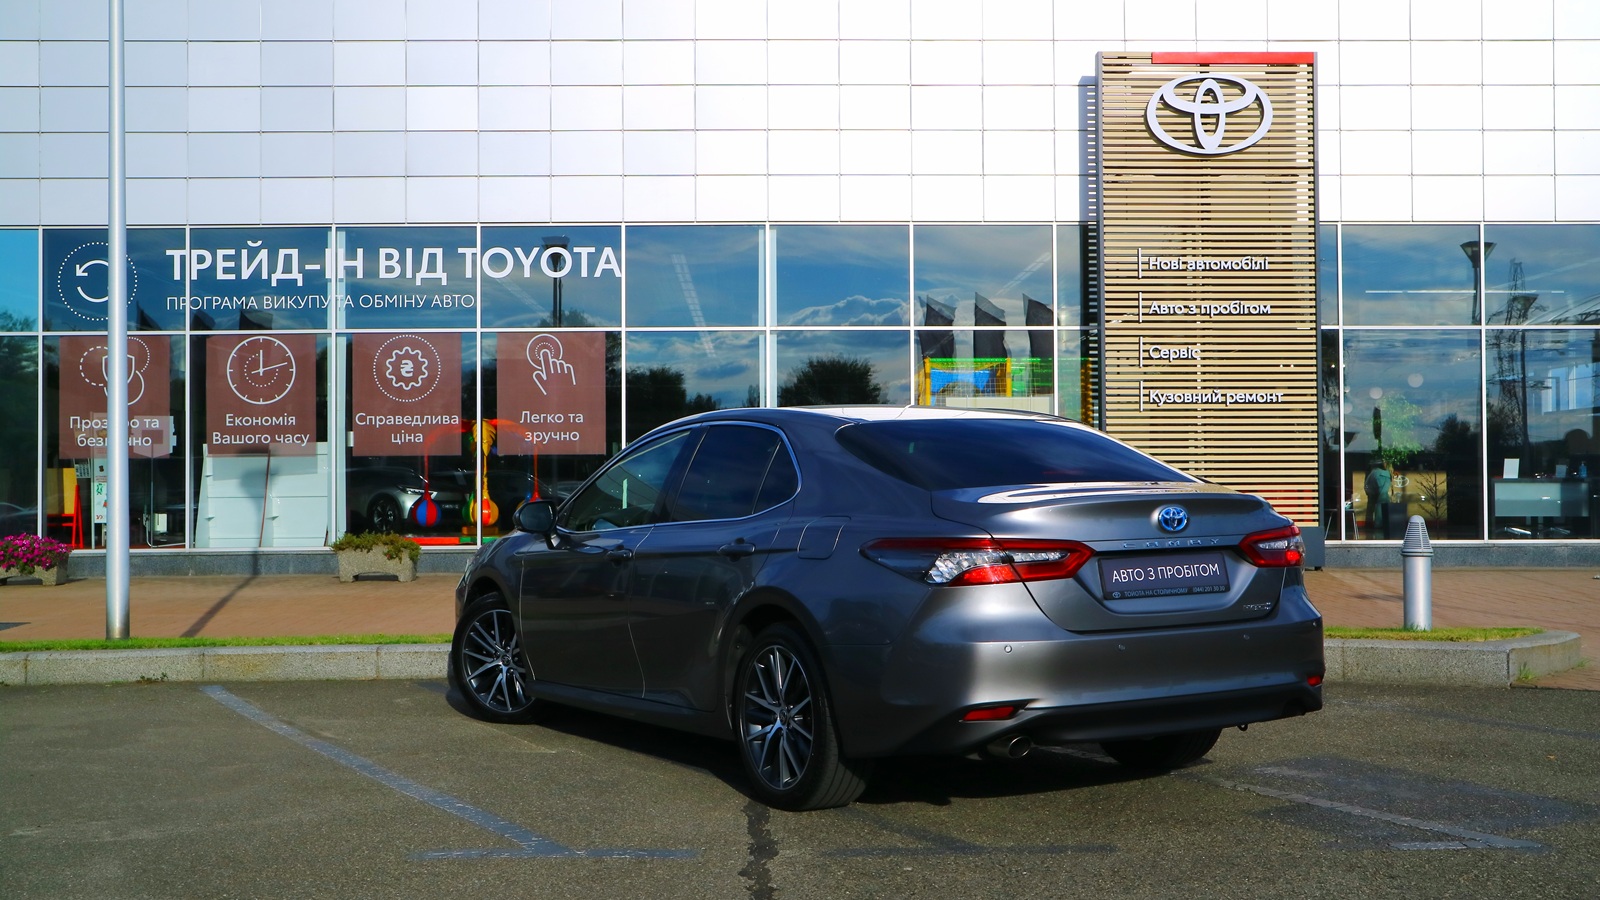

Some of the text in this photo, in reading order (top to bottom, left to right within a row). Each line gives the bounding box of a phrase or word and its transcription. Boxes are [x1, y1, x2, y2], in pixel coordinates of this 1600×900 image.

[165, 240, 622, 287] ТРЕЙД-ІН ВІД TOYOTA
[1149, 256, 1269, 271] Нові автомобілі
[166, 293, 476, 311] ПРОГРАМА ВИКУПУ ТА ОБМІНУ АВТО
[1149, 300, 1272, 318] Авто з пробігом
[1149, 346, 1201, 362] Сервіс
[1149, 390, 1284, 407] Кузовний ремонт
[143, 418, 160, 429] та
[225, 413, 296, 427] Економія
[355, 412, 460, 429] Справедлива
[520, 411, 584, 426] Легко та
[212, 432, 310, 447] Вашого часу
[391, 432, 424, 444] ціна
[525, 431, 579, 445] зручно
[1112, 568, 1145, 584] АВТО
[1158, 563, 1220, 581] ПРОБІГОМ
